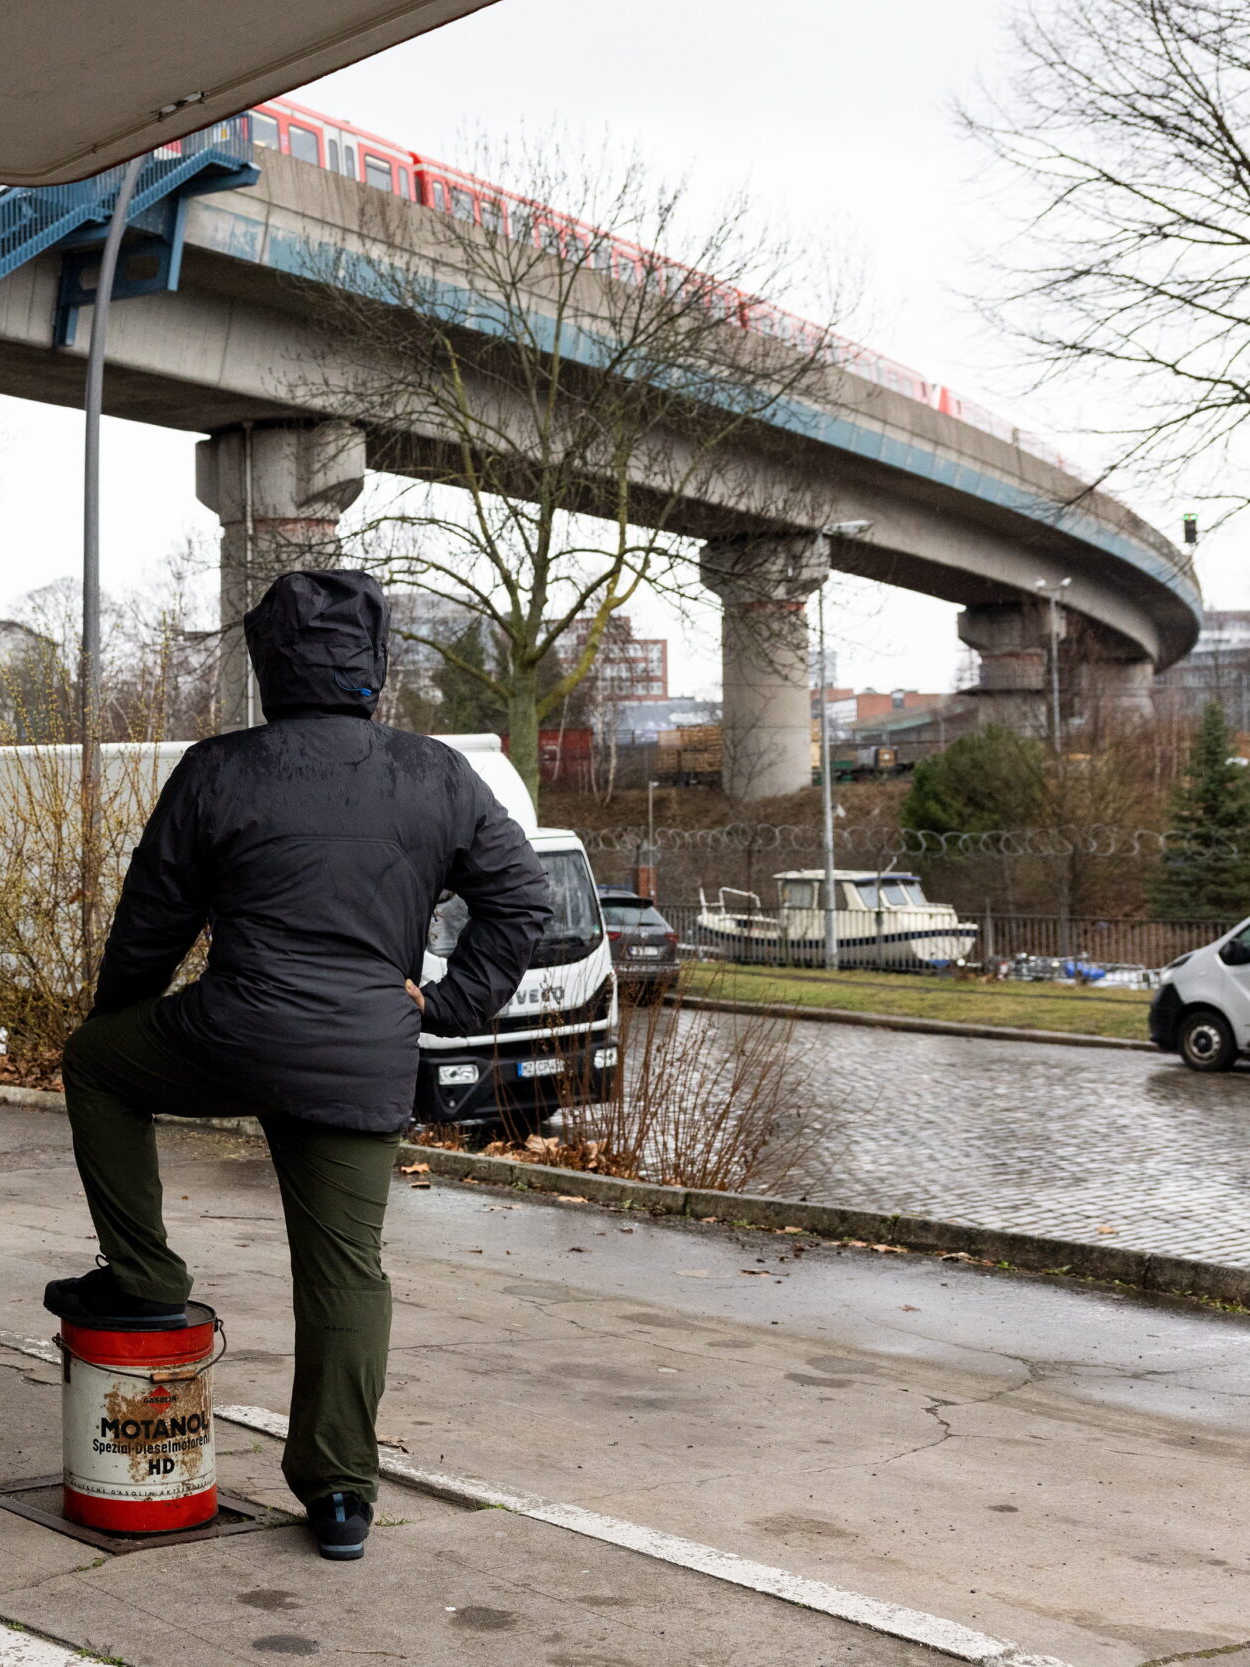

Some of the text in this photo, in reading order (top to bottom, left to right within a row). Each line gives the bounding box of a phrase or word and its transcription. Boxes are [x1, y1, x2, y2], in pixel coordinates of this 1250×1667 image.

[143, 1395, 177, 1404] GASOLIN
[100, 1410, 209, 1440] MOTANOL
[148, 1457, 176, 1476] HD
